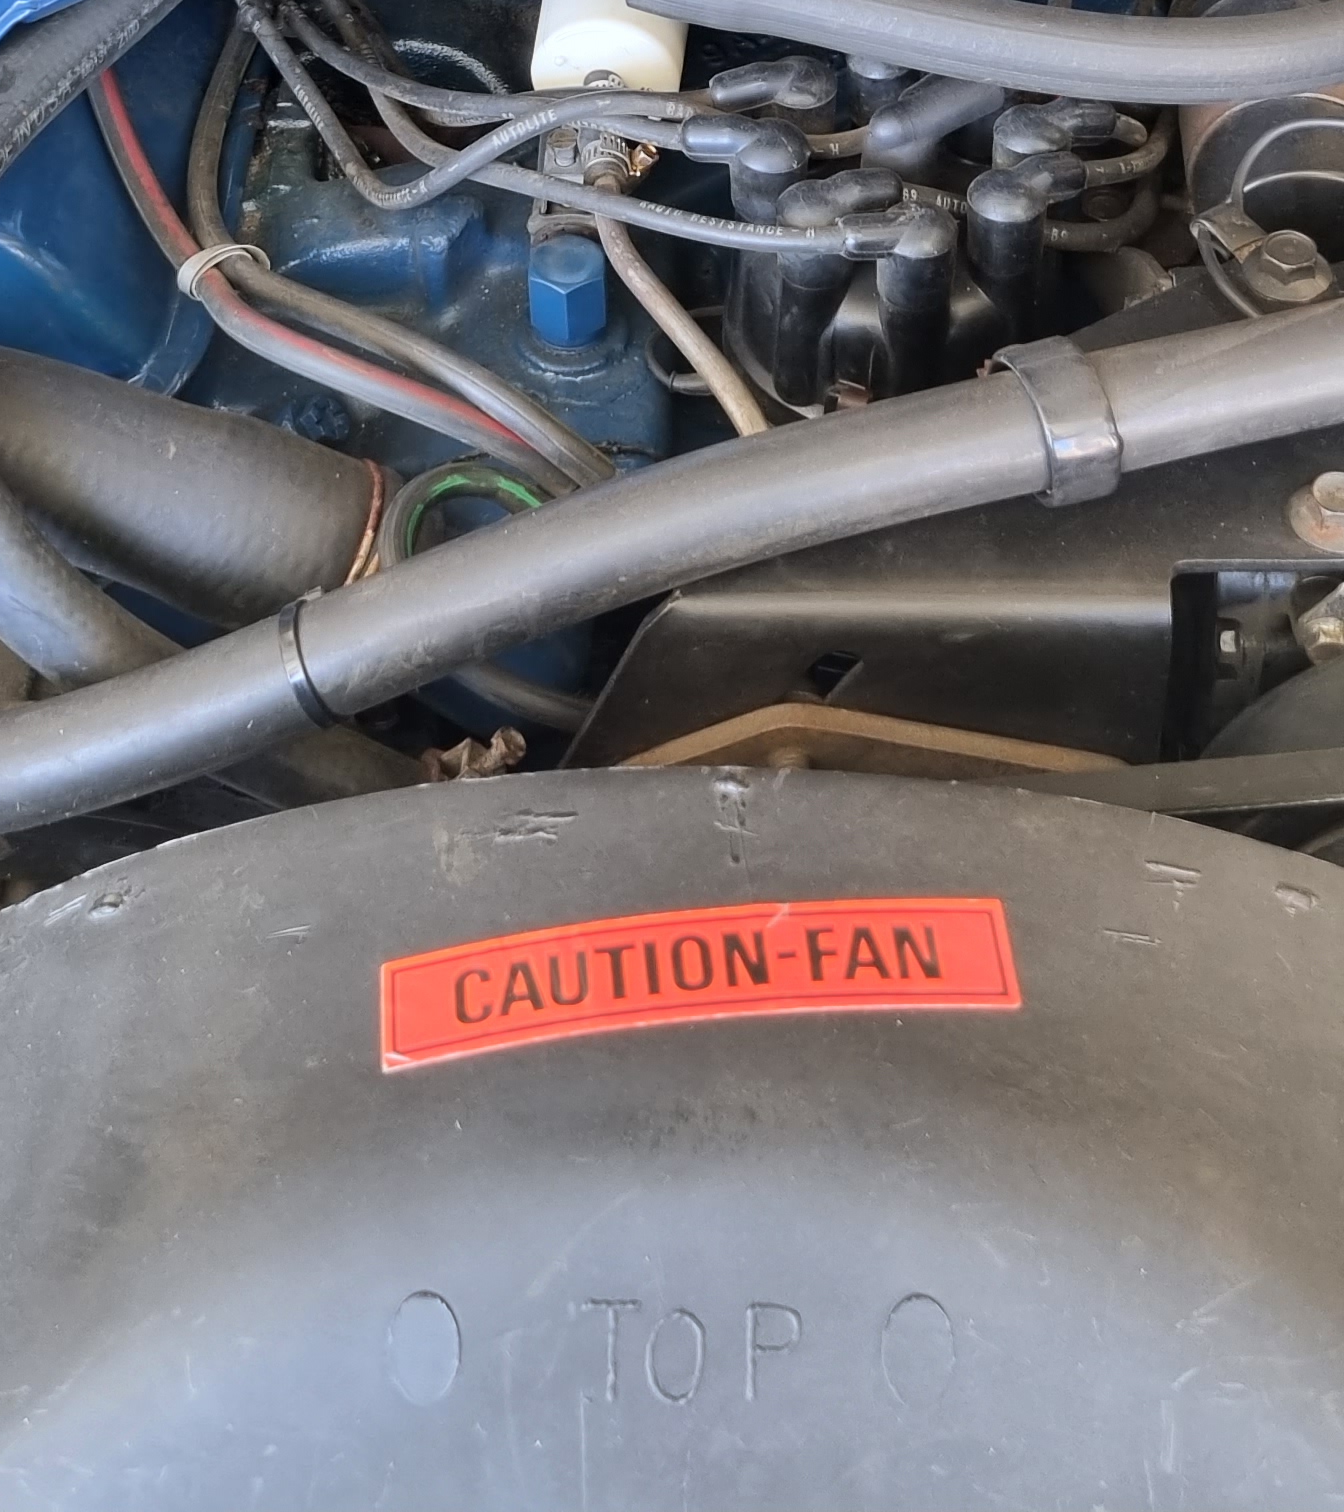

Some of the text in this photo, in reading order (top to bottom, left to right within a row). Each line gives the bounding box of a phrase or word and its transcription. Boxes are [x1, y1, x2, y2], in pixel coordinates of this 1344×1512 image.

[492, 108, 558, 148] AUTOLITE
[689, 214, 784, 237] RESISTANCE
[454, 924, 944, 1025] CAUTION-FAN
[581, 1297, 803, 1403] TOP
